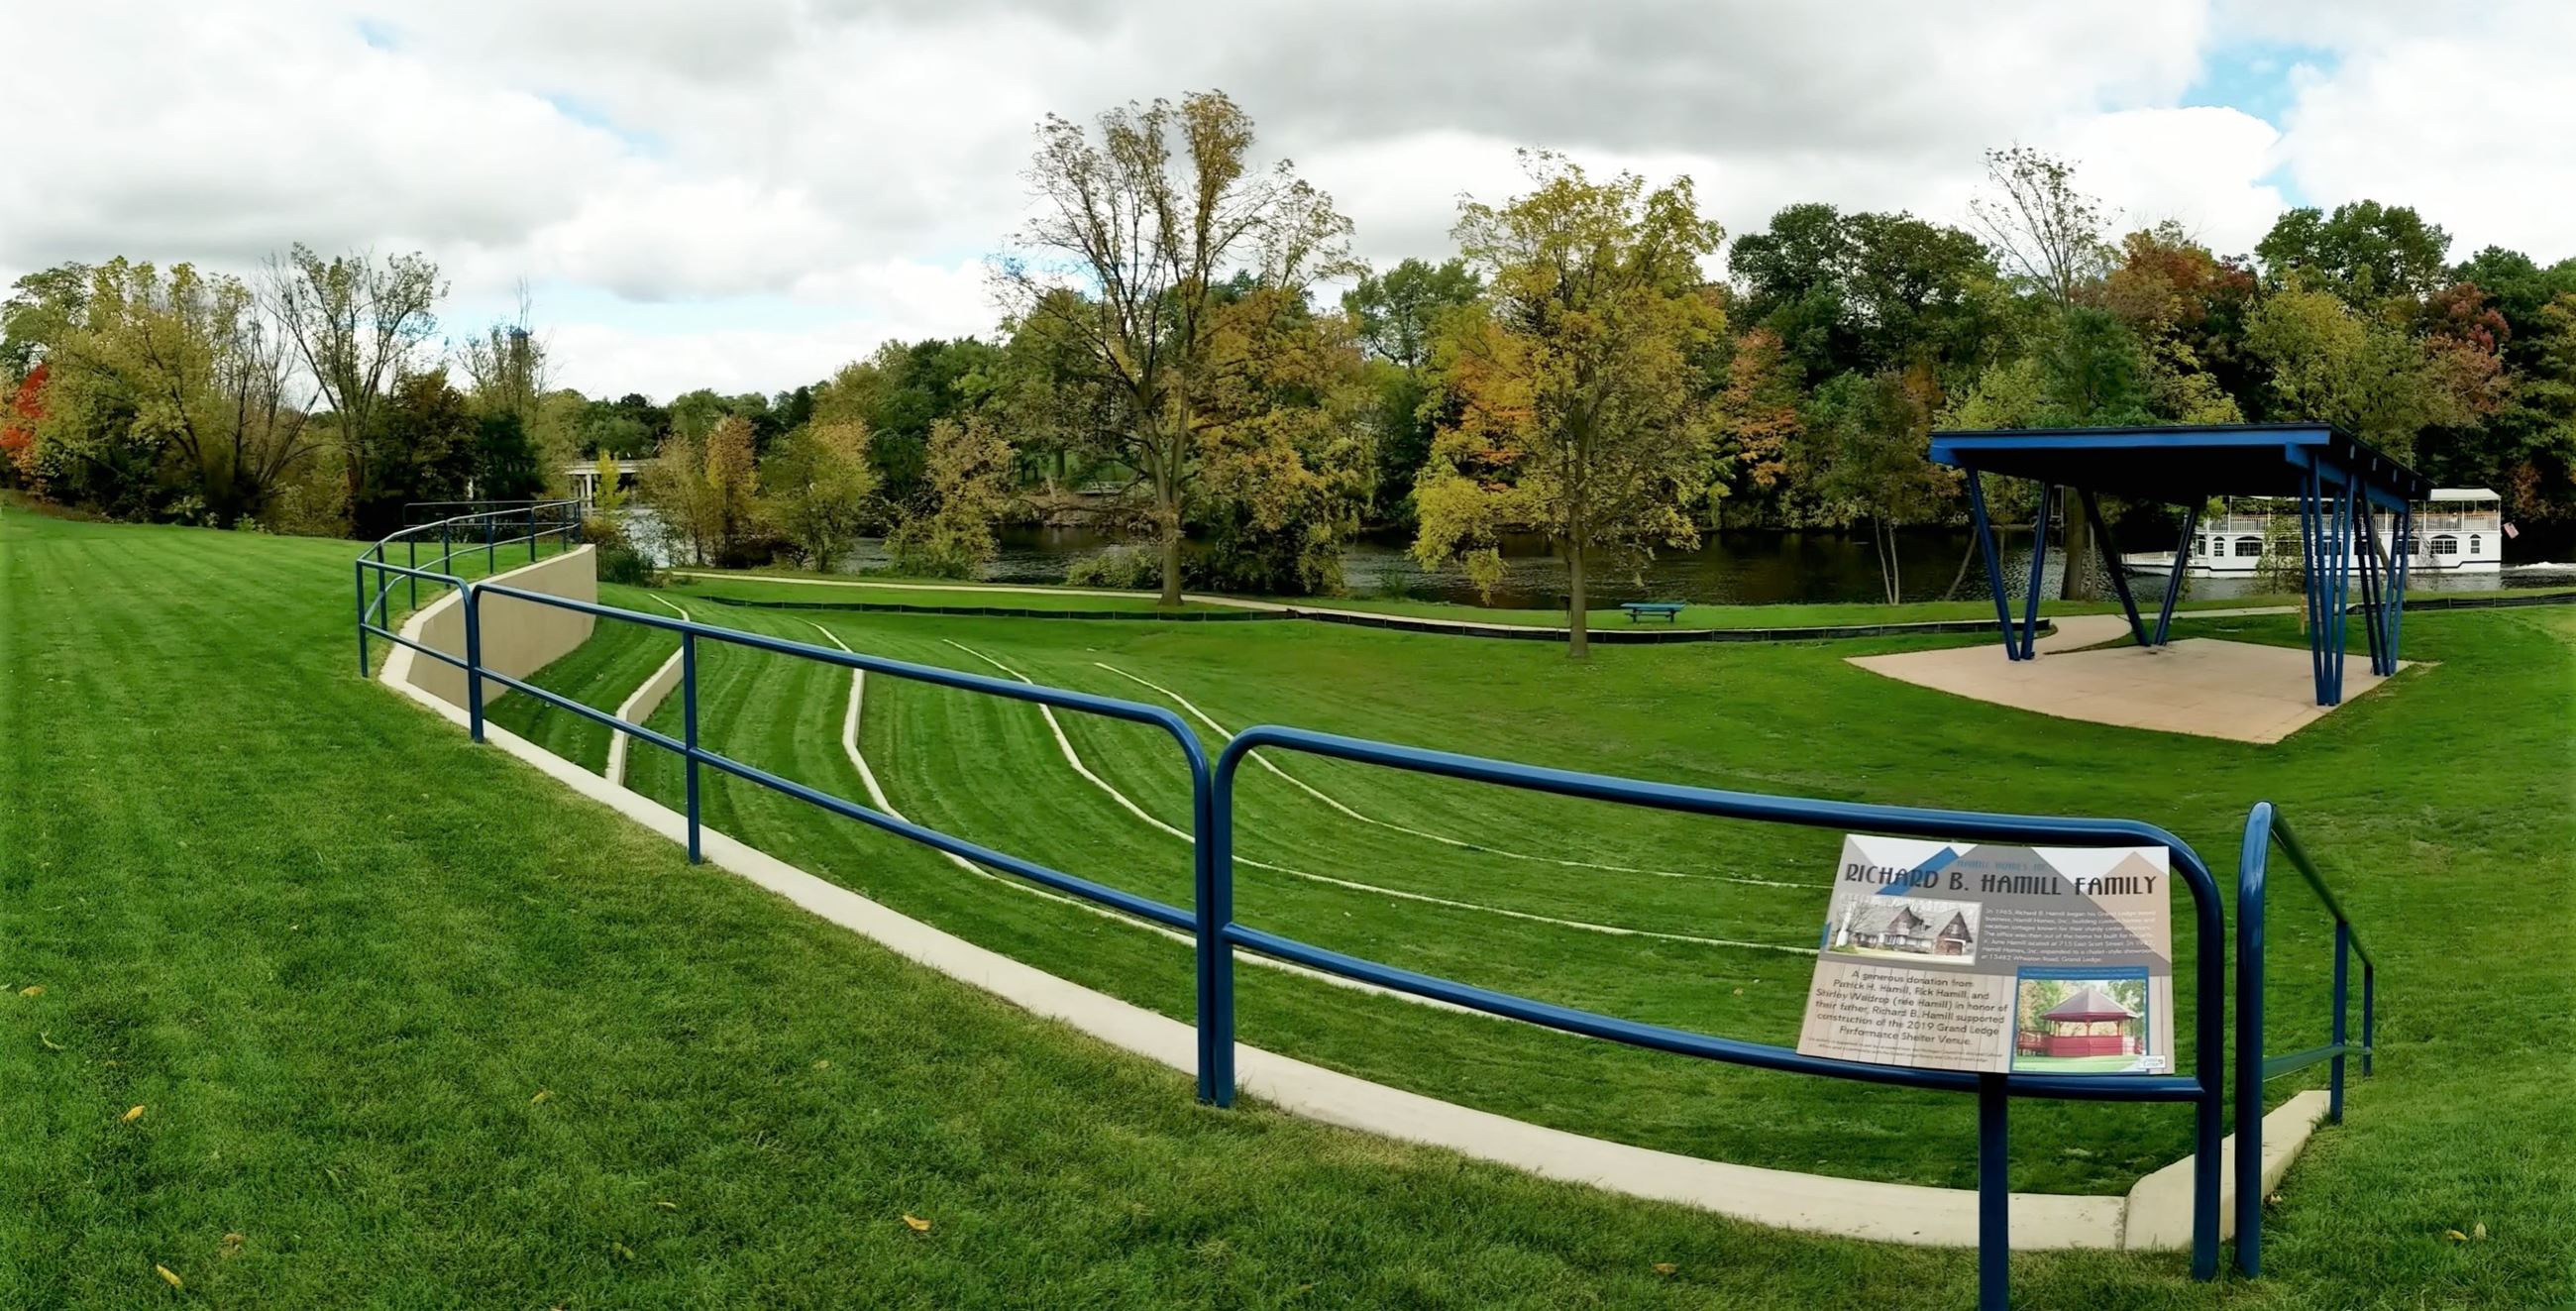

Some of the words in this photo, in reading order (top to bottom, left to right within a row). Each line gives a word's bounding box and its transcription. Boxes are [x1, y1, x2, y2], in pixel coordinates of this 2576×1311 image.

[1845, 863, 1939, 889] RICHARD
[1949, 872, 1969, 891] B.
[1981, 874, 2062, 896] HAMILL
[2075, 875, 2157, 896] FAMILY
[1833, 979, 1865, 991] Patrick
[1880, 984, 1911, 995] Hamill,
[1915, 987, 1934, 997] Rick
[1862, 973, 1904, 982] generous
[1906, 976, 1948, 987] donation
[1952, 979, 1973, 988] from
[1815, 988, 1848, 1001] Shirley
[1918, 999, 1952, 1011] Hamill)
[1967, 1002, 1994, 1011] honor
[1815, 1001, 1837, 1010] their
[1873, 1006, 1907, 1017] Richard
[1910, 1009, 1921, 1018] B.
[1922, 1011, 1954, 1021] Hamill
[1956, 1014, 2004, 1025] supported
[1817, 1013, 1873, 1026] construction
[1888, 1019, 1903, 1029] the
[1906, 1021, 1934, 1030] 2019
[1936, 1023, 1968, 1034] Grand
[1970, 1026, 1999, 1037] Ledge
[1839, 1026, 1899, 1040] Performance
[1901, 1032, 1935, 1042] Shelter
